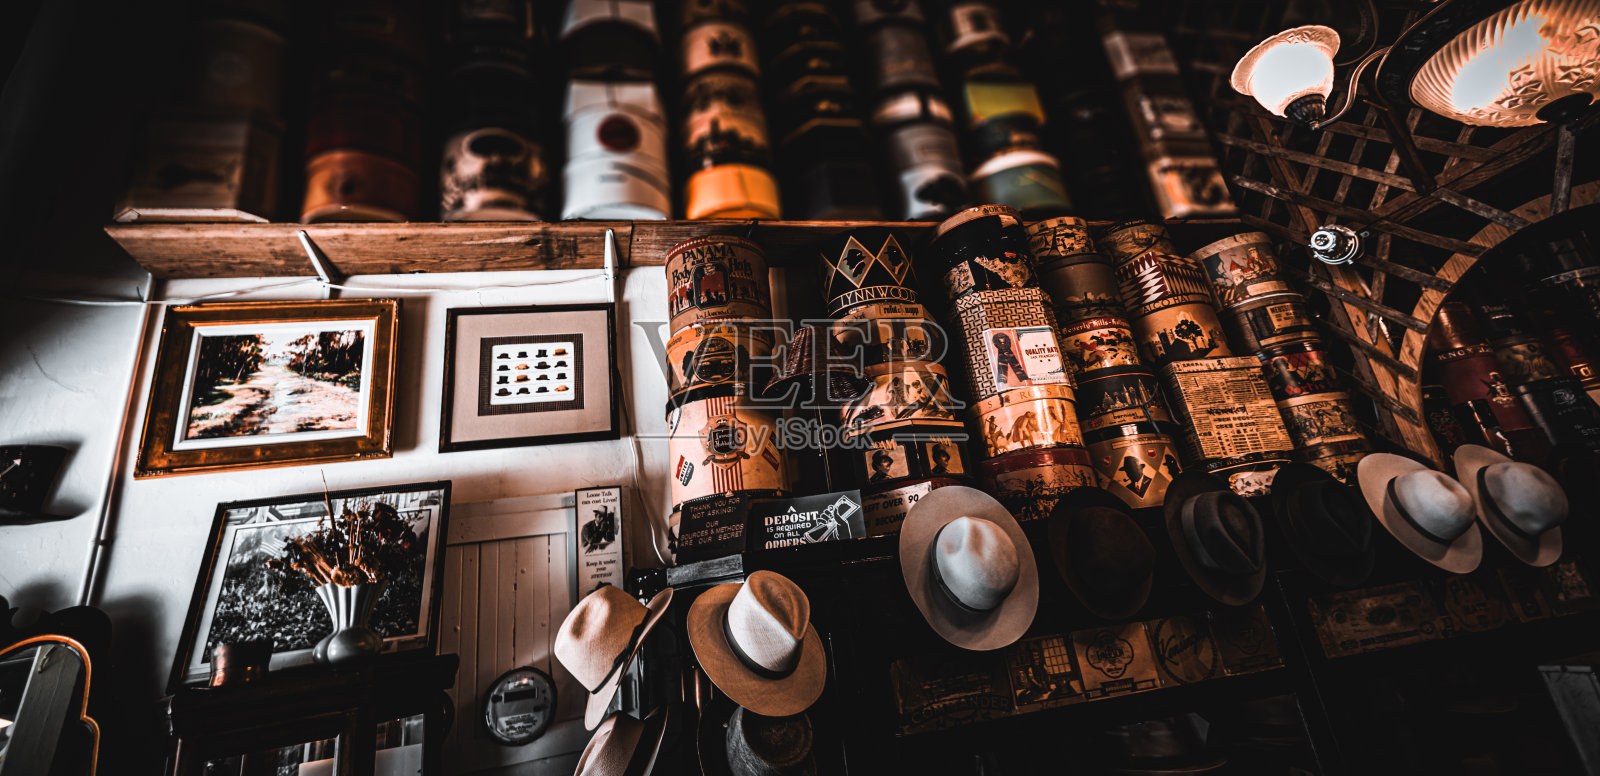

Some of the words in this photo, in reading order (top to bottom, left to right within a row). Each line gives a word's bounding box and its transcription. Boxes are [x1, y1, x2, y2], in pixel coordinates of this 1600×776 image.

[682, 245, 736, 264] PANAMA
[691, 258, 704, 266] and
[707, 256, 724, 264] other
[671, 265, 694, 287] Body
[727, 258, 753, 279] Hats
[840, 285, 916, 308] LYNNWOOD
[1025, 347, 1046, 357] QUALITY
[679, 461, 688, 482] UNITED
[690, 502, 711, 513] THANK
[714, 500, 726, 508] YOU
[728, 497, 740, 505] FOR
[787, 505, 796, 513] A
[864, 503, 880, 513] LEFT
[882, 497, 903, 509] OVER
[908, 494, 919, 503] 90
[692, 511, 705, 520] NOT
[764, 510, 819, 527] DEPOSIT
[681, 530, 709, 541] SOURCES
[715, 523, 744, 534] METHODS
[705, 520, 719, 529] OUR
[776, 522, 812, 532] REQUIRED
[680, 539, 693, 547] ARE
[698, 536, 713, 545] OUR
[717, 530, 743, 541] SECRET
[765, 537, 807, 550] ORDERS
[590, 572, 613, 580] STETSON
[911, 695, 1010, 724] COMMANDER
